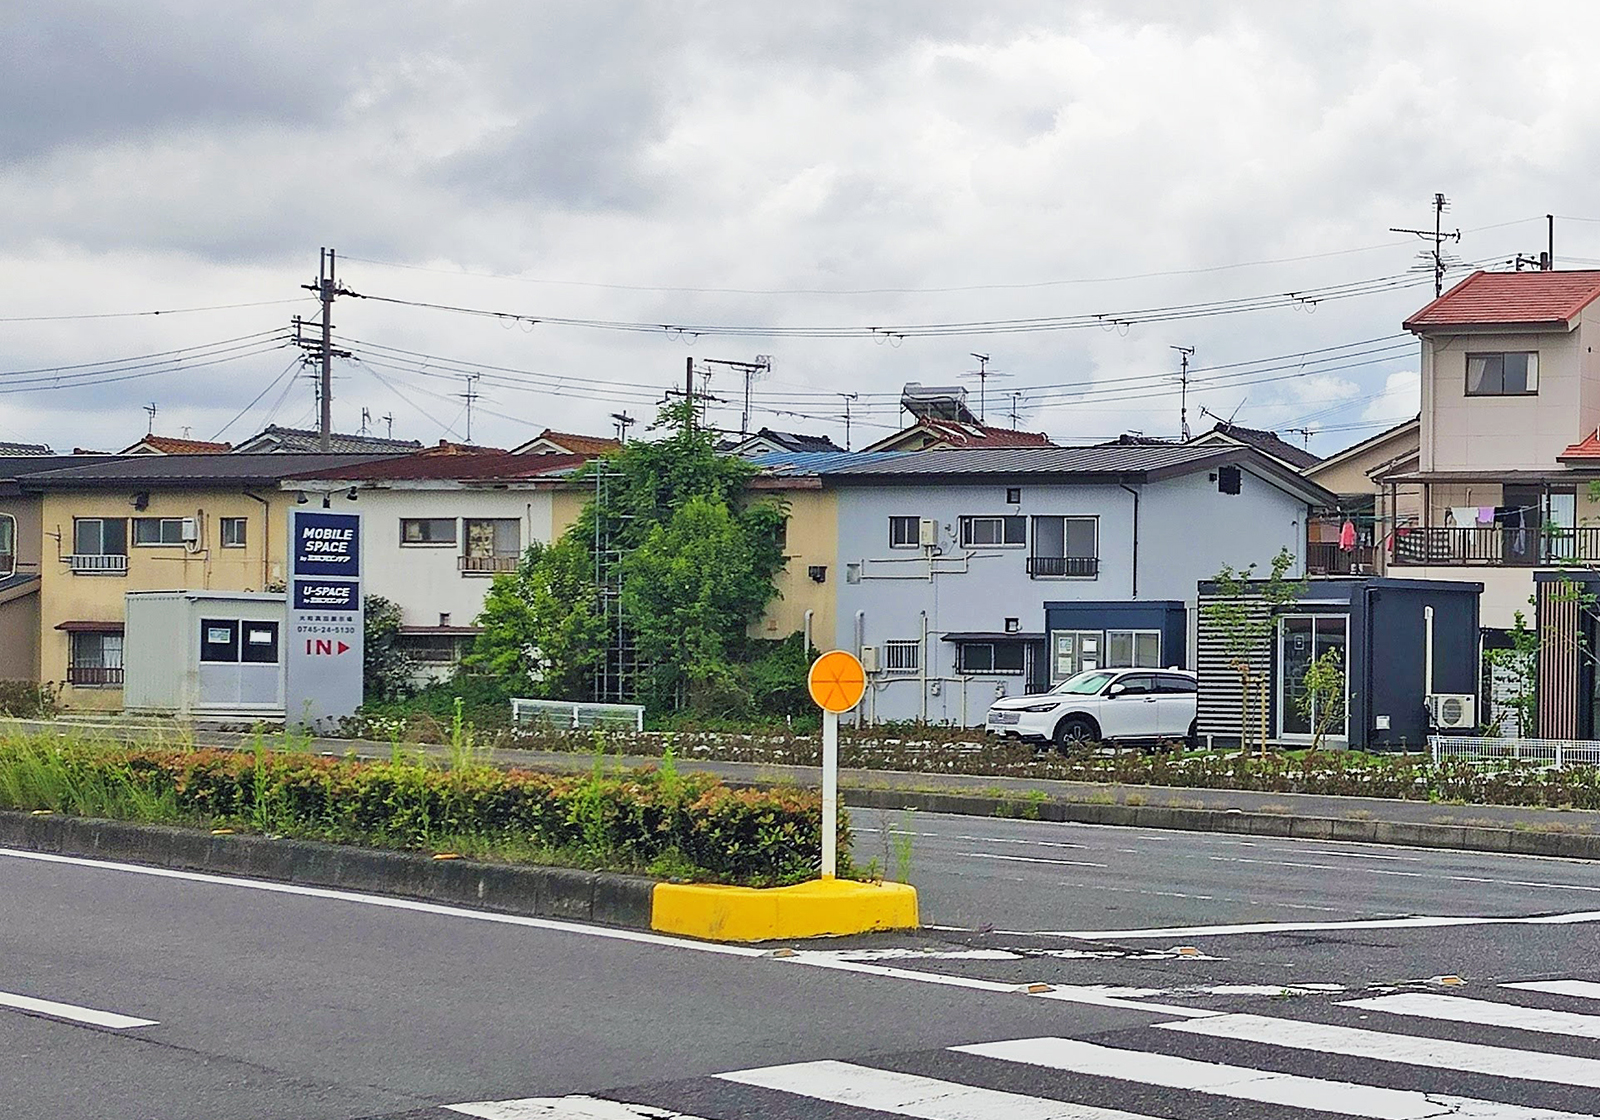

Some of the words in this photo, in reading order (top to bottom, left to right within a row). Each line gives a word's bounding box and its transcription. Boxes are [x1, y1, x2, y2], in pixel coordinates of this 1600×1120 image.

[303, 528, 353, 540] MOBILE
[305, 541, 348, 553] SPACE
[303, 586, 350, 597] U-SPACE
[307, 640, 331, 655] IN
